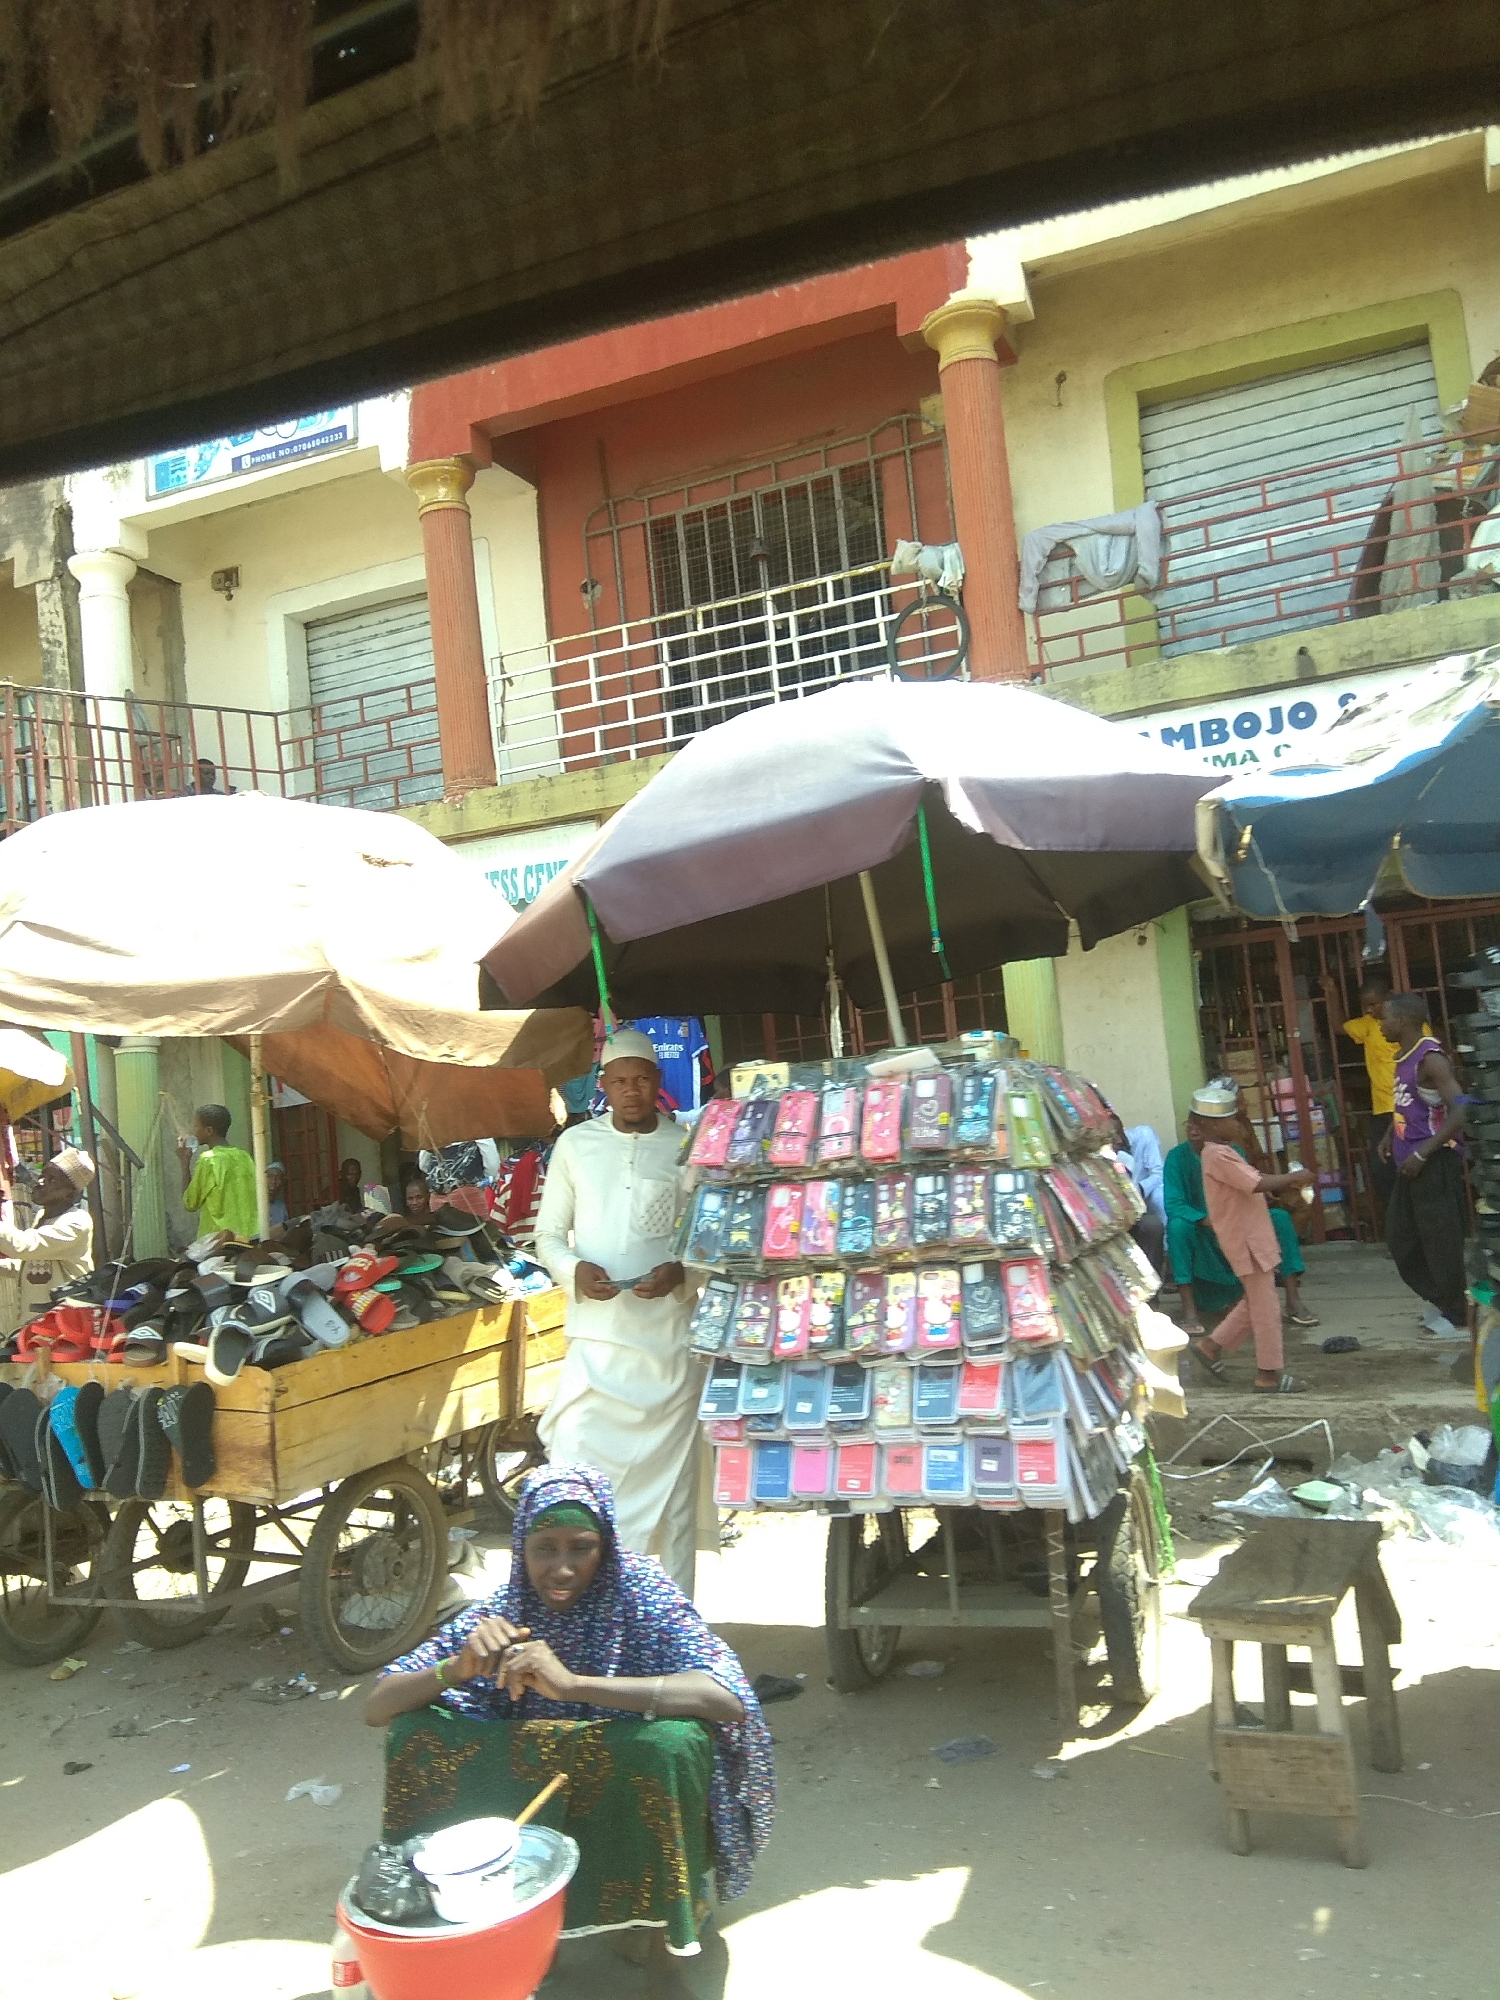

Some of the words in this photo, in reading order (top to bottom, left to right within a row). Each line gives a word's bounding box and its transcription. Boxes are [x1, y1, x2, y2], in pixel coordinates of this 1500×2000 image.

[252, 451, 276, 464] PHONE
[1139, 701, 1317, 750] MBOJO
[485, 868, 518, 904] ESS
